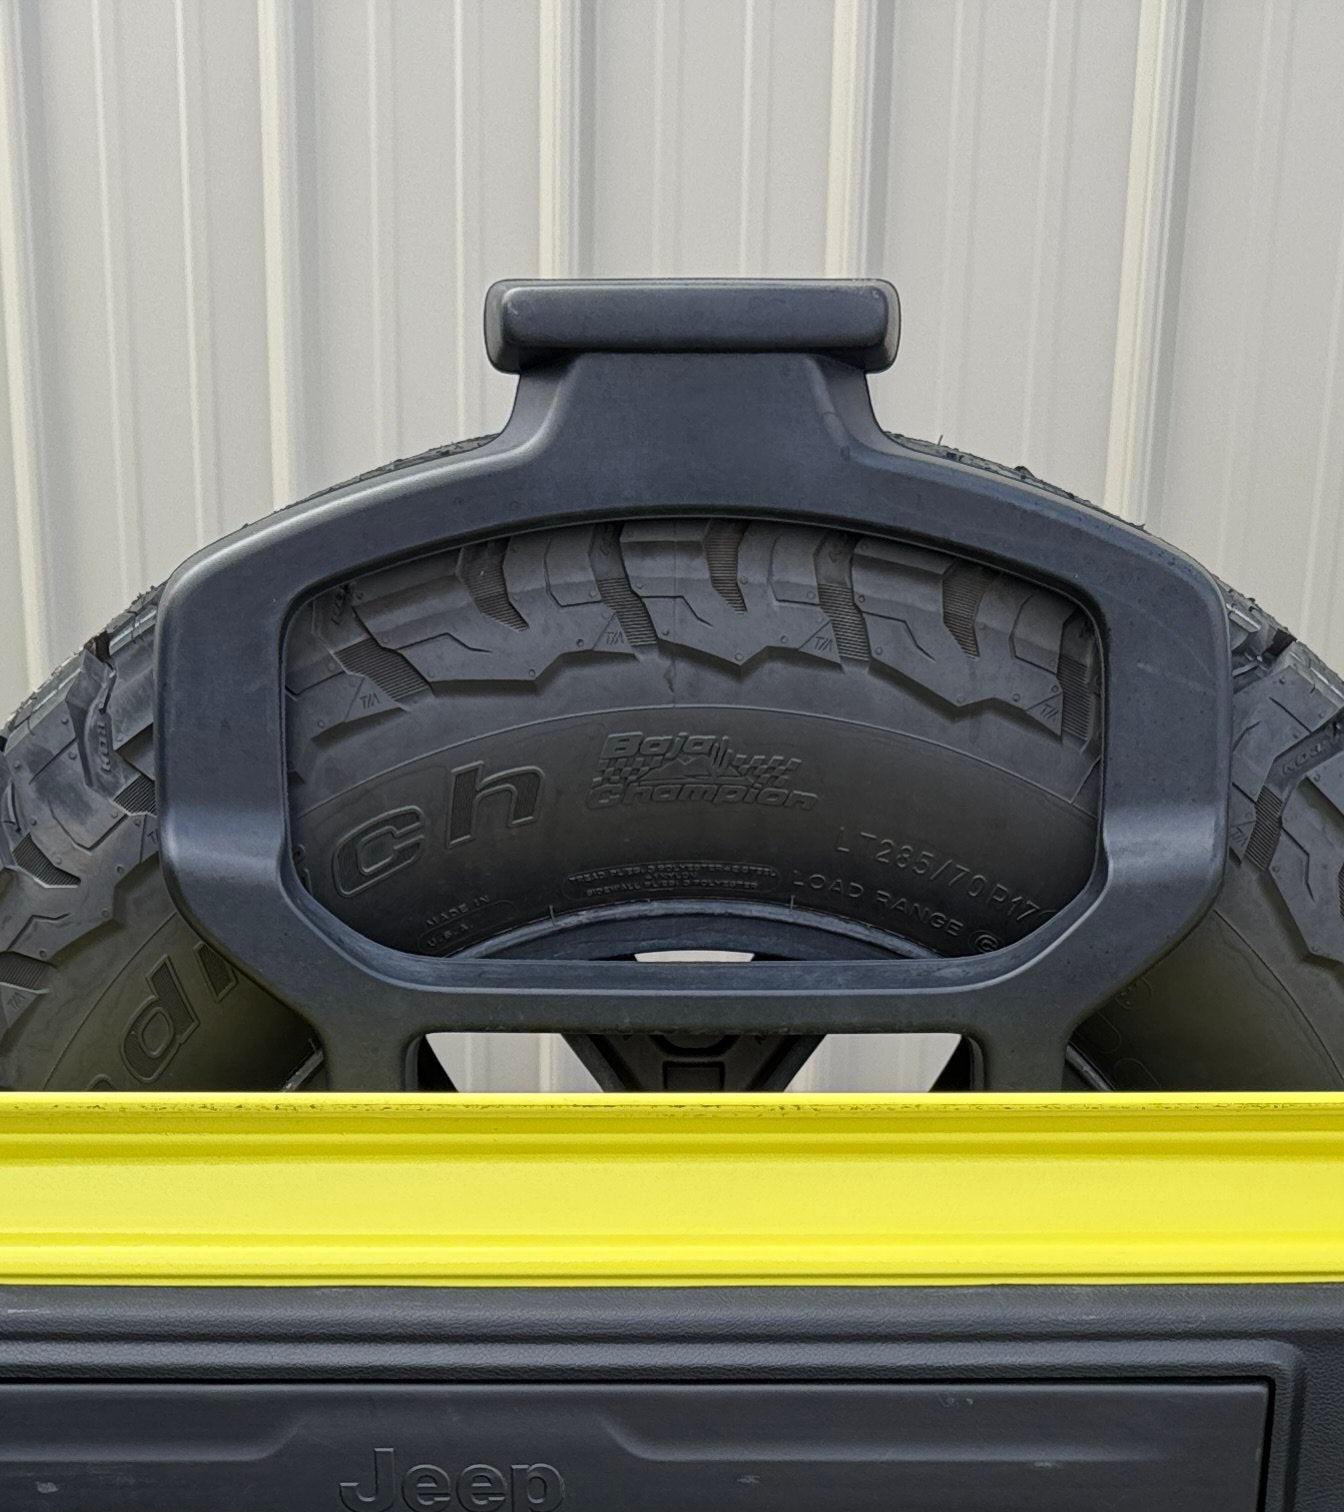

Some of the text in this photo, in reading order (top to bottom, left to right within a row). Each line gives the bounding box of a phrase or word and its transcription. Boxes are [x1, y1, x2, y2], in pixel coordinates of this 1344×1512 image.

[602, 731, 717, 760] Baja
[586, 782, 820, 810] Champion
[424, 894, 491, 927] MADE IN
[792, 868, 864, 899] LOAD
[873, 888, 965, 937] RANGE
